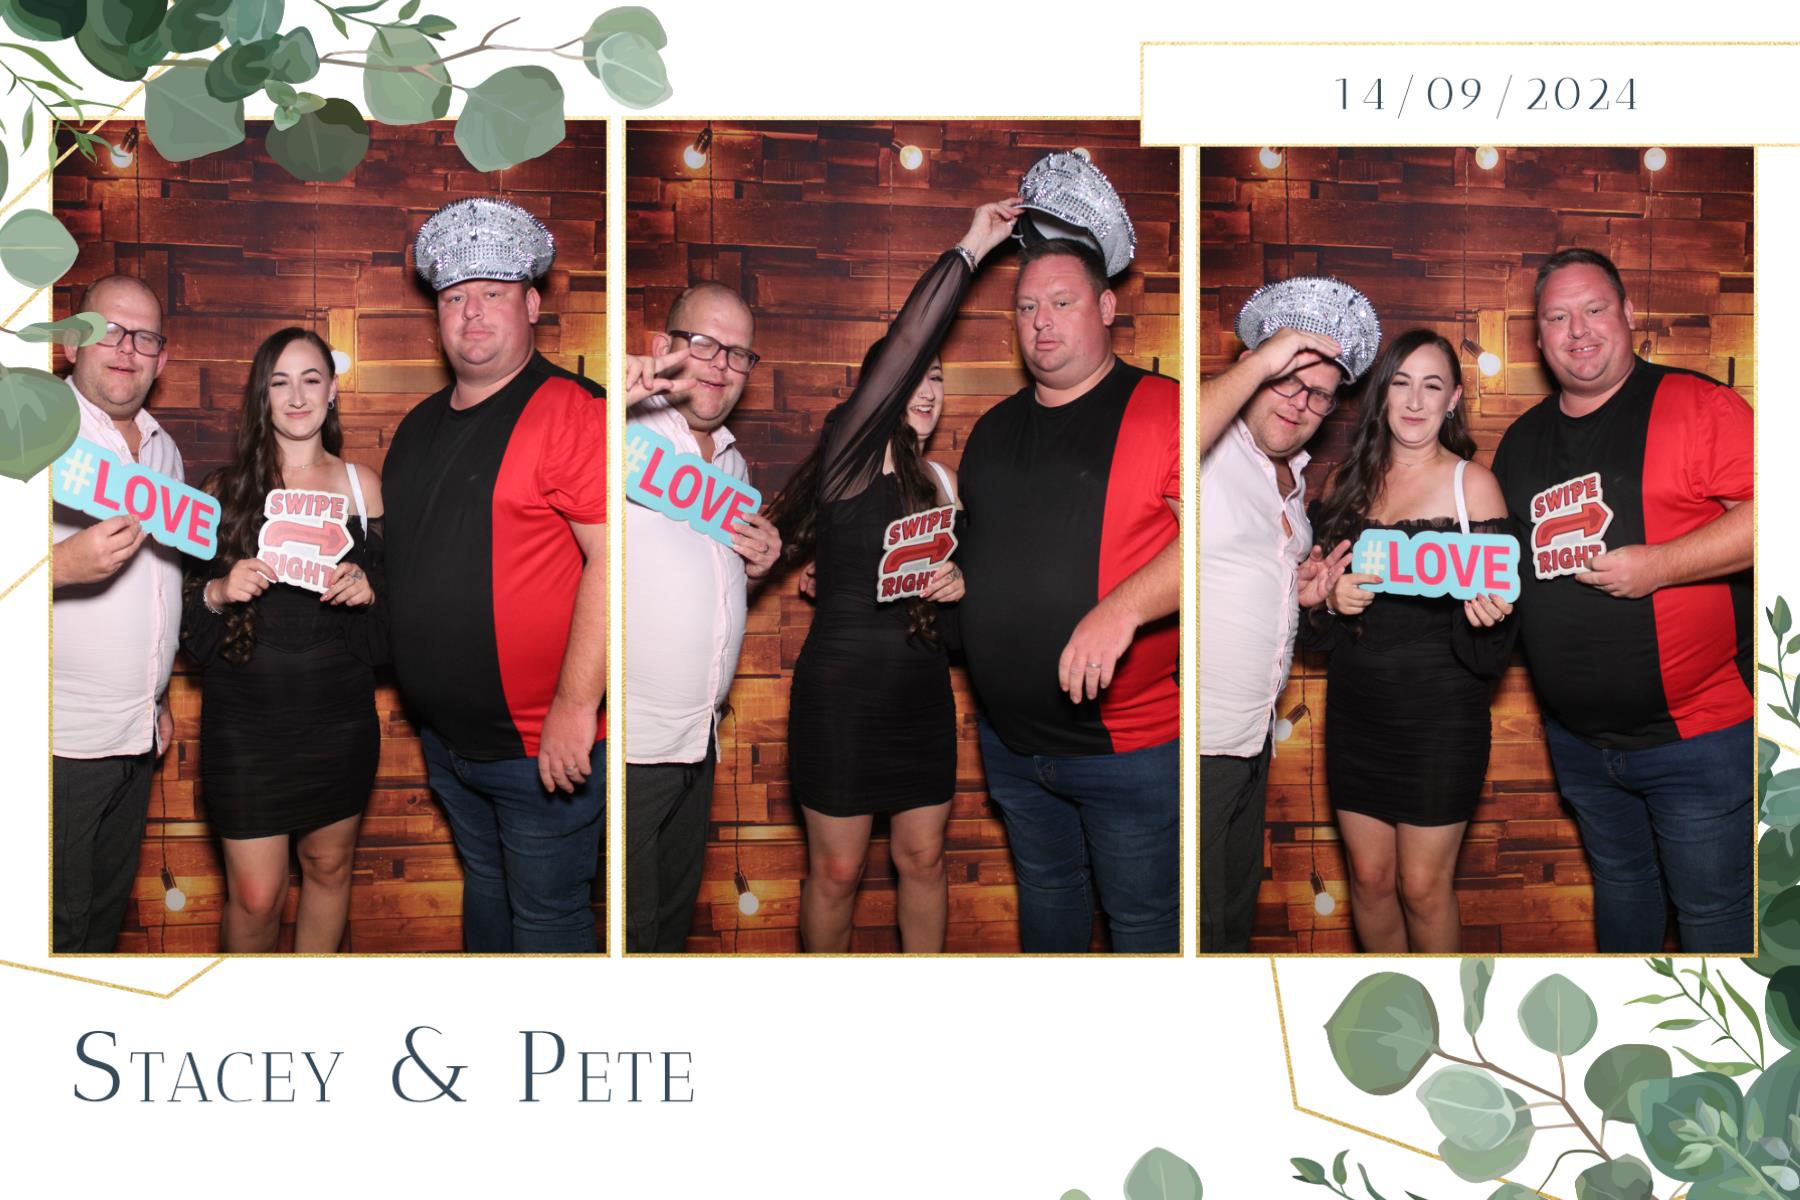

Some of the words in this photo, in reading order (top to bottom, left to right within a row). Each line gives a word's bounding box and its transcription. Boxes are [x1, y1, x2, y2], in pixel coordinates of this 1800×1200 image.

[61, 448, 214, 547] #LOVE
[269, 492, 344, 519] SWIPE
[625, 435, 755, 535] #LOVE
[1534, 476, 1598, 518] SWIPE
[889, 507, 954, 545] SWIPE
[881, 569, 939, 597] RIGH
[1360, 540, 1511, 590] #LOVE
